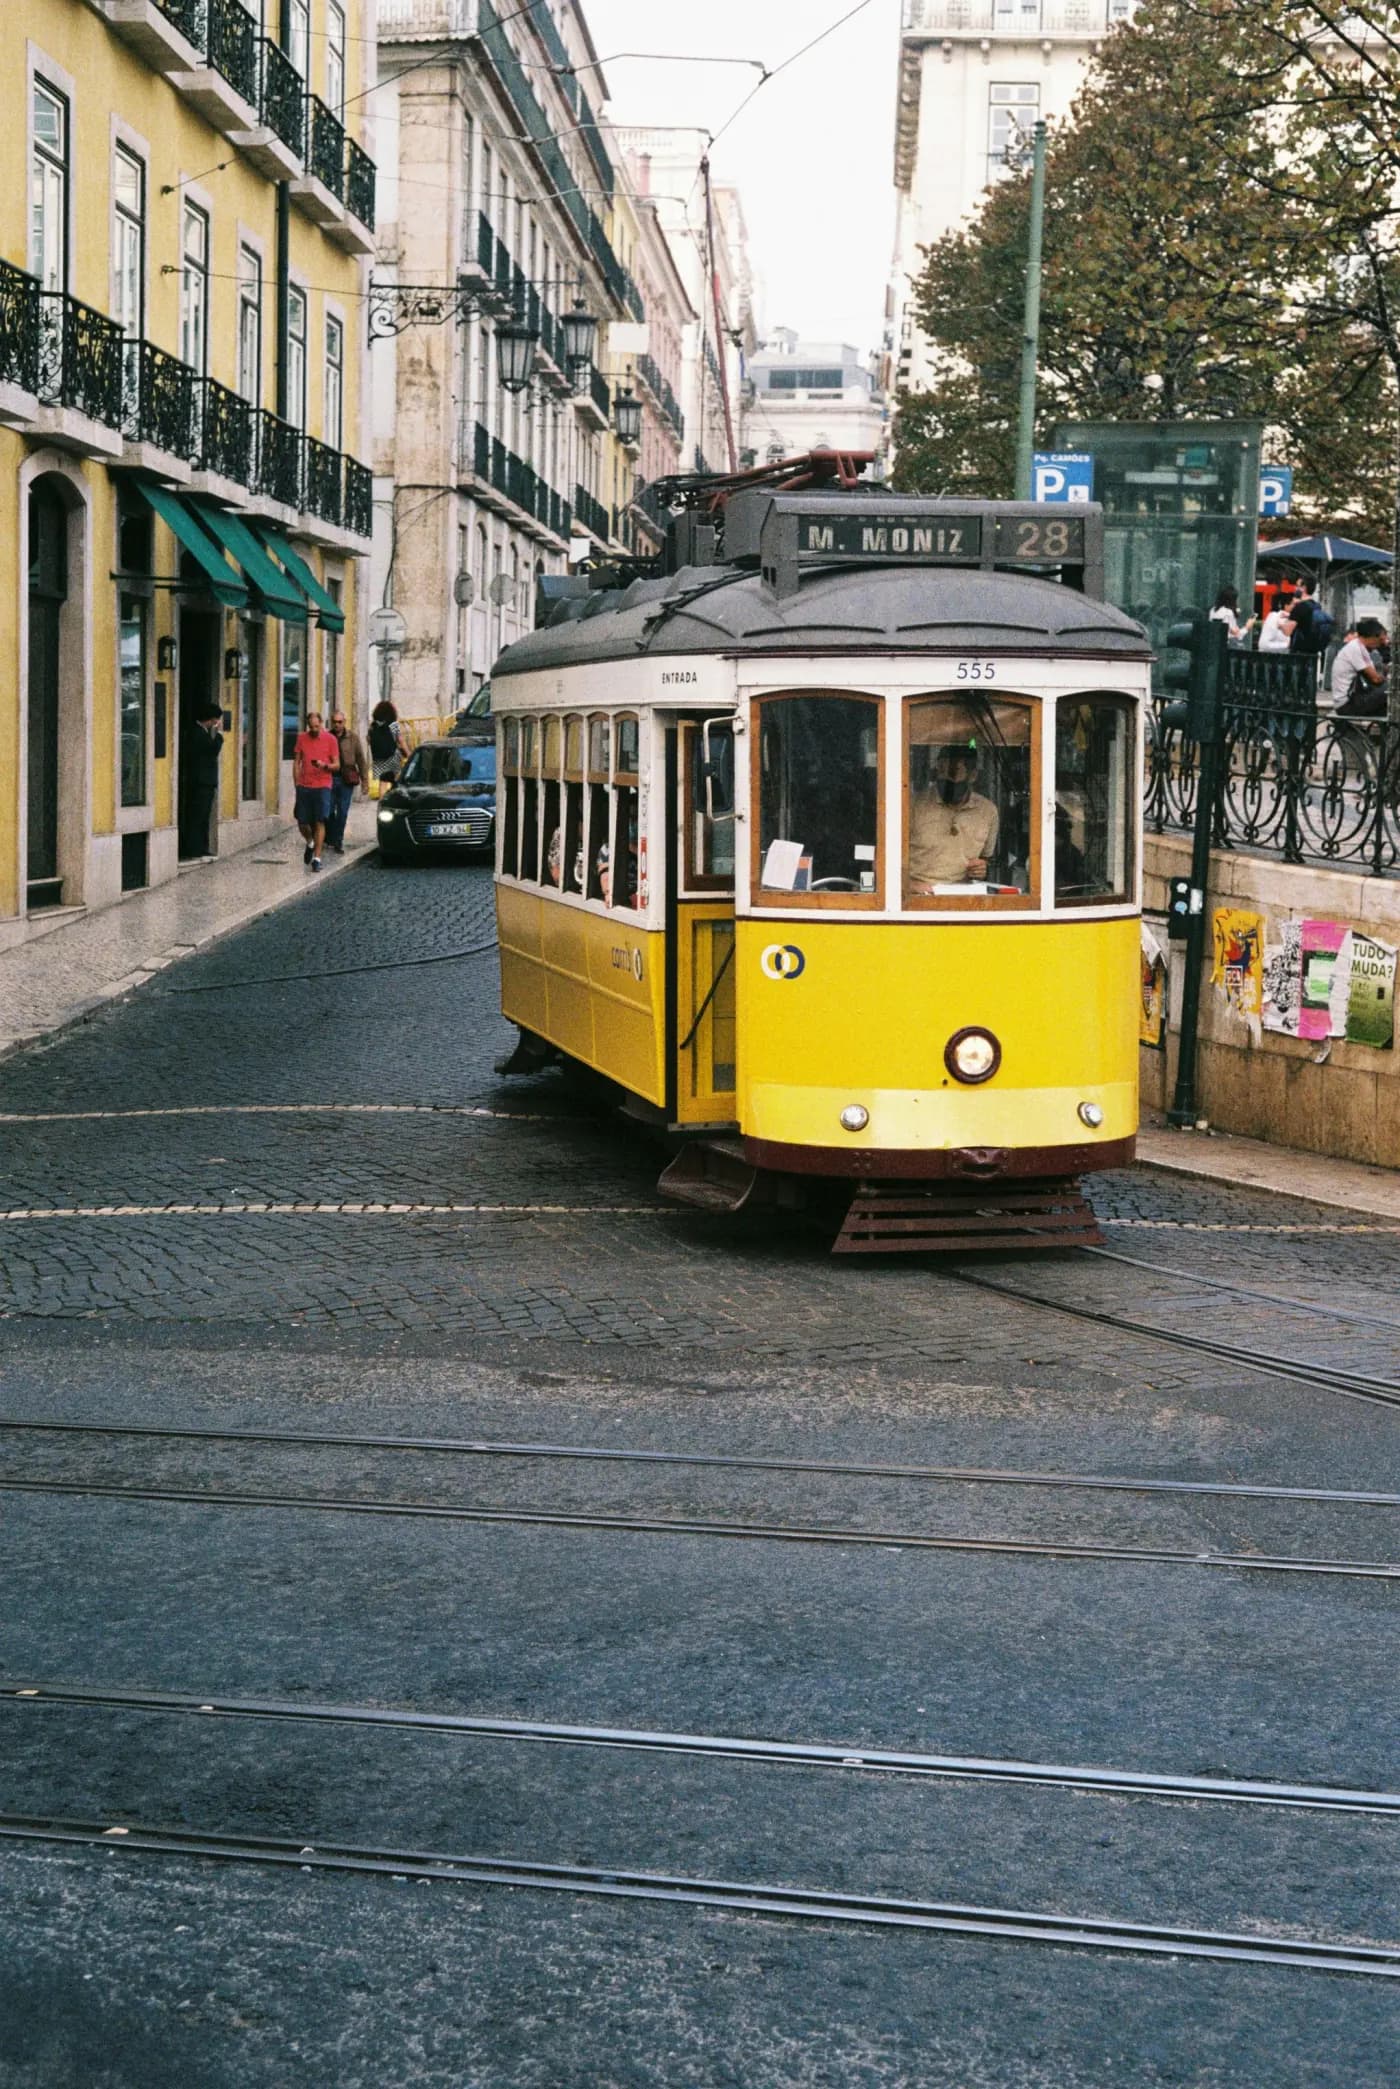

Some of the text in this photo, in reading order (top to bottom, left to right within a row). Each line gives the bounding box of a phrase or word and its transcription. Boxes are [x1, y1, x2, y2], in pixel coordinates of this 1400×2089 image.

[1036, 468, 1065, 502] P
[1259, 480, 1283, 512] P
[808, 526, 963, 553] M. MONIZ
[1016, 522, 1068, 557] 28
[661, 671, 698, 684] ENTRADA
[956, 662, 995, 679] 555
[1353, 943, 1386, 961] TUDO
[1352, 960, 1393, 979] MUDA?
